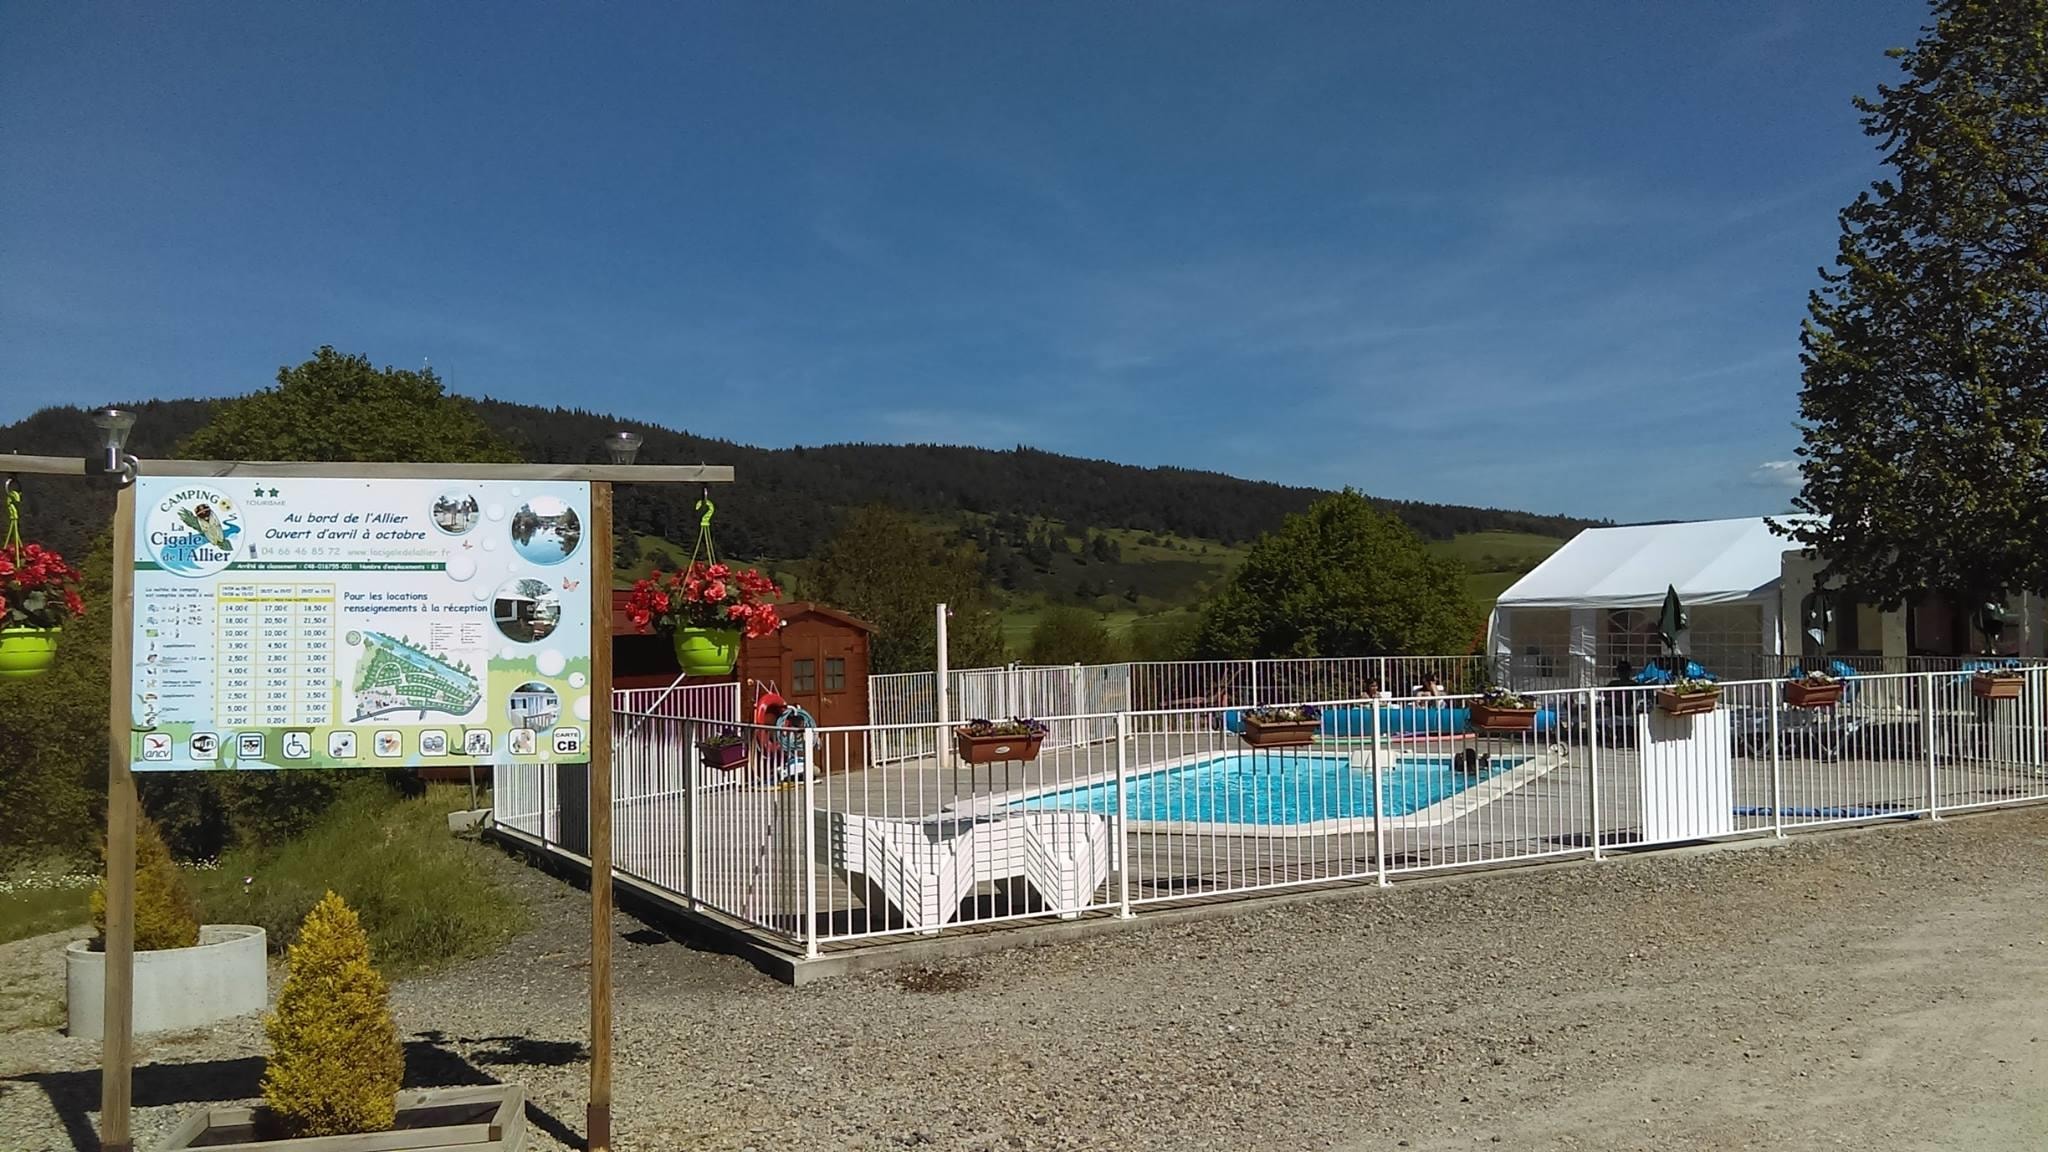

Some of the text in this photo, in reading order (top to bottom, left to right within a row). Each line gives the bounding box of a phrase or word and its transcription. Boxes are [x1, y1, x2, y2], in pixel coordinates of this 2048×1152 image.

[160, 489, 220, 512] CAMPING
[284, 512, 408, 523] Au bord de l'Allier
[171, 522, 185, 531] La
[265, 528, 426, 540] Ouvert d'avril à octobre
[151, 531, 202, 548] Cigale
[261, 547, 274, 555] 04
[278, 547, 290, 555] 66
[328, 547, 340, 555] 72
[162, 553, 175, 561] de
[344, 592, 428, 600] Pour les locations
[344, 604, 488, 614] renseignements à la réception
[557, 741, 577, 751] CB
